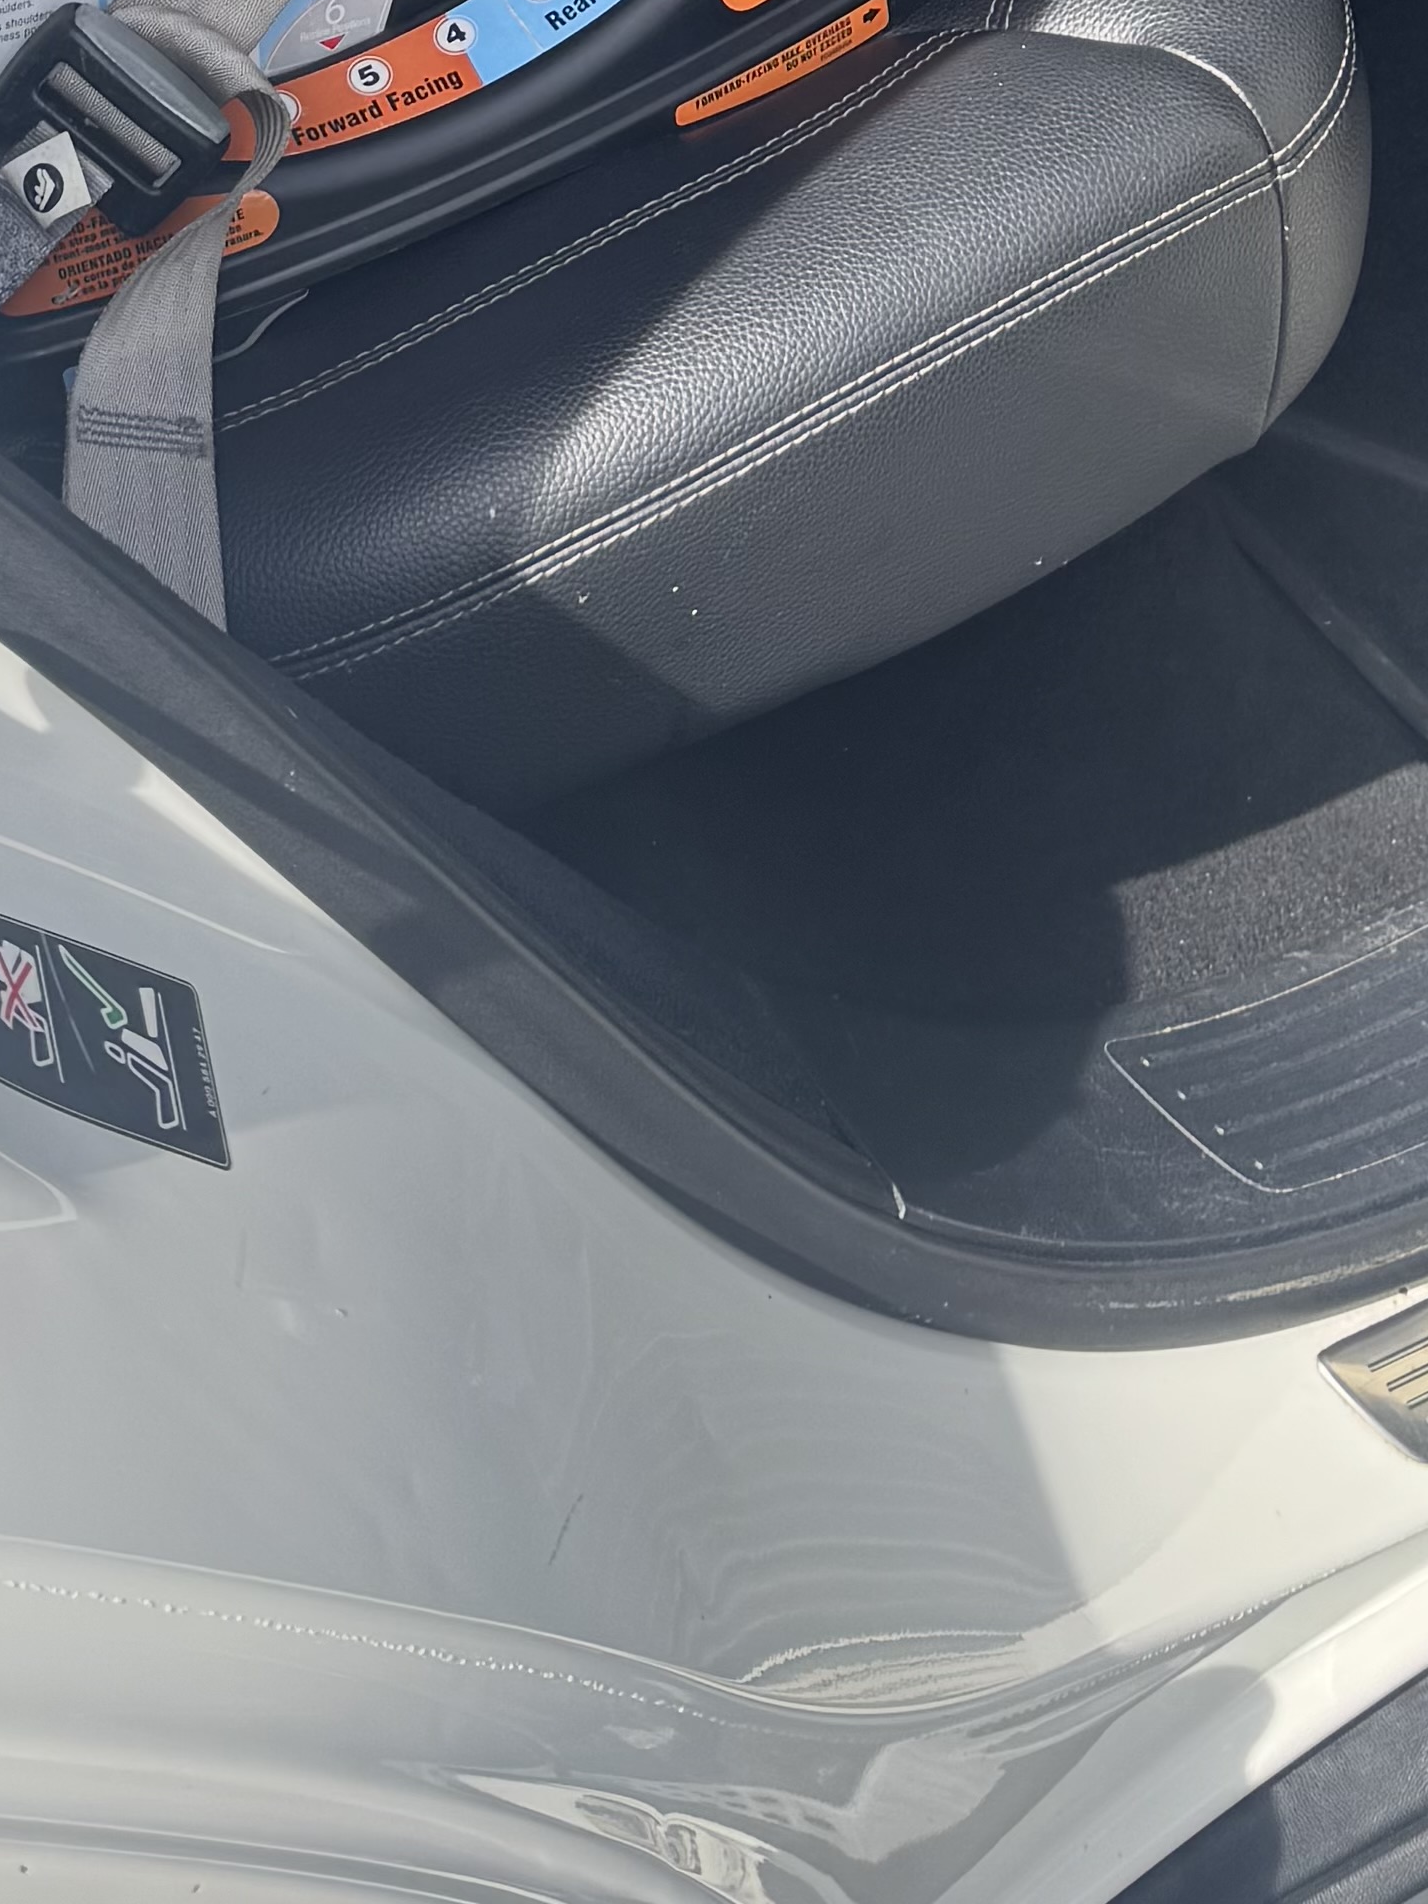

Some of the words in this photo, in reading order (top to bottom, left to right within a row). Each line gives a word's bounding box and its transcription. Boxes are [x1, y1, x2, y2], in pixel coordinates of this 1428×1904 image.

[447, 23, 466, 44] 4
[359, 65, 380, 87] 5
[292, 103, 385, 148] Forward
[390, 71, 464, 112] Facing
[58, 265, 132, 310] ORIENTADO
